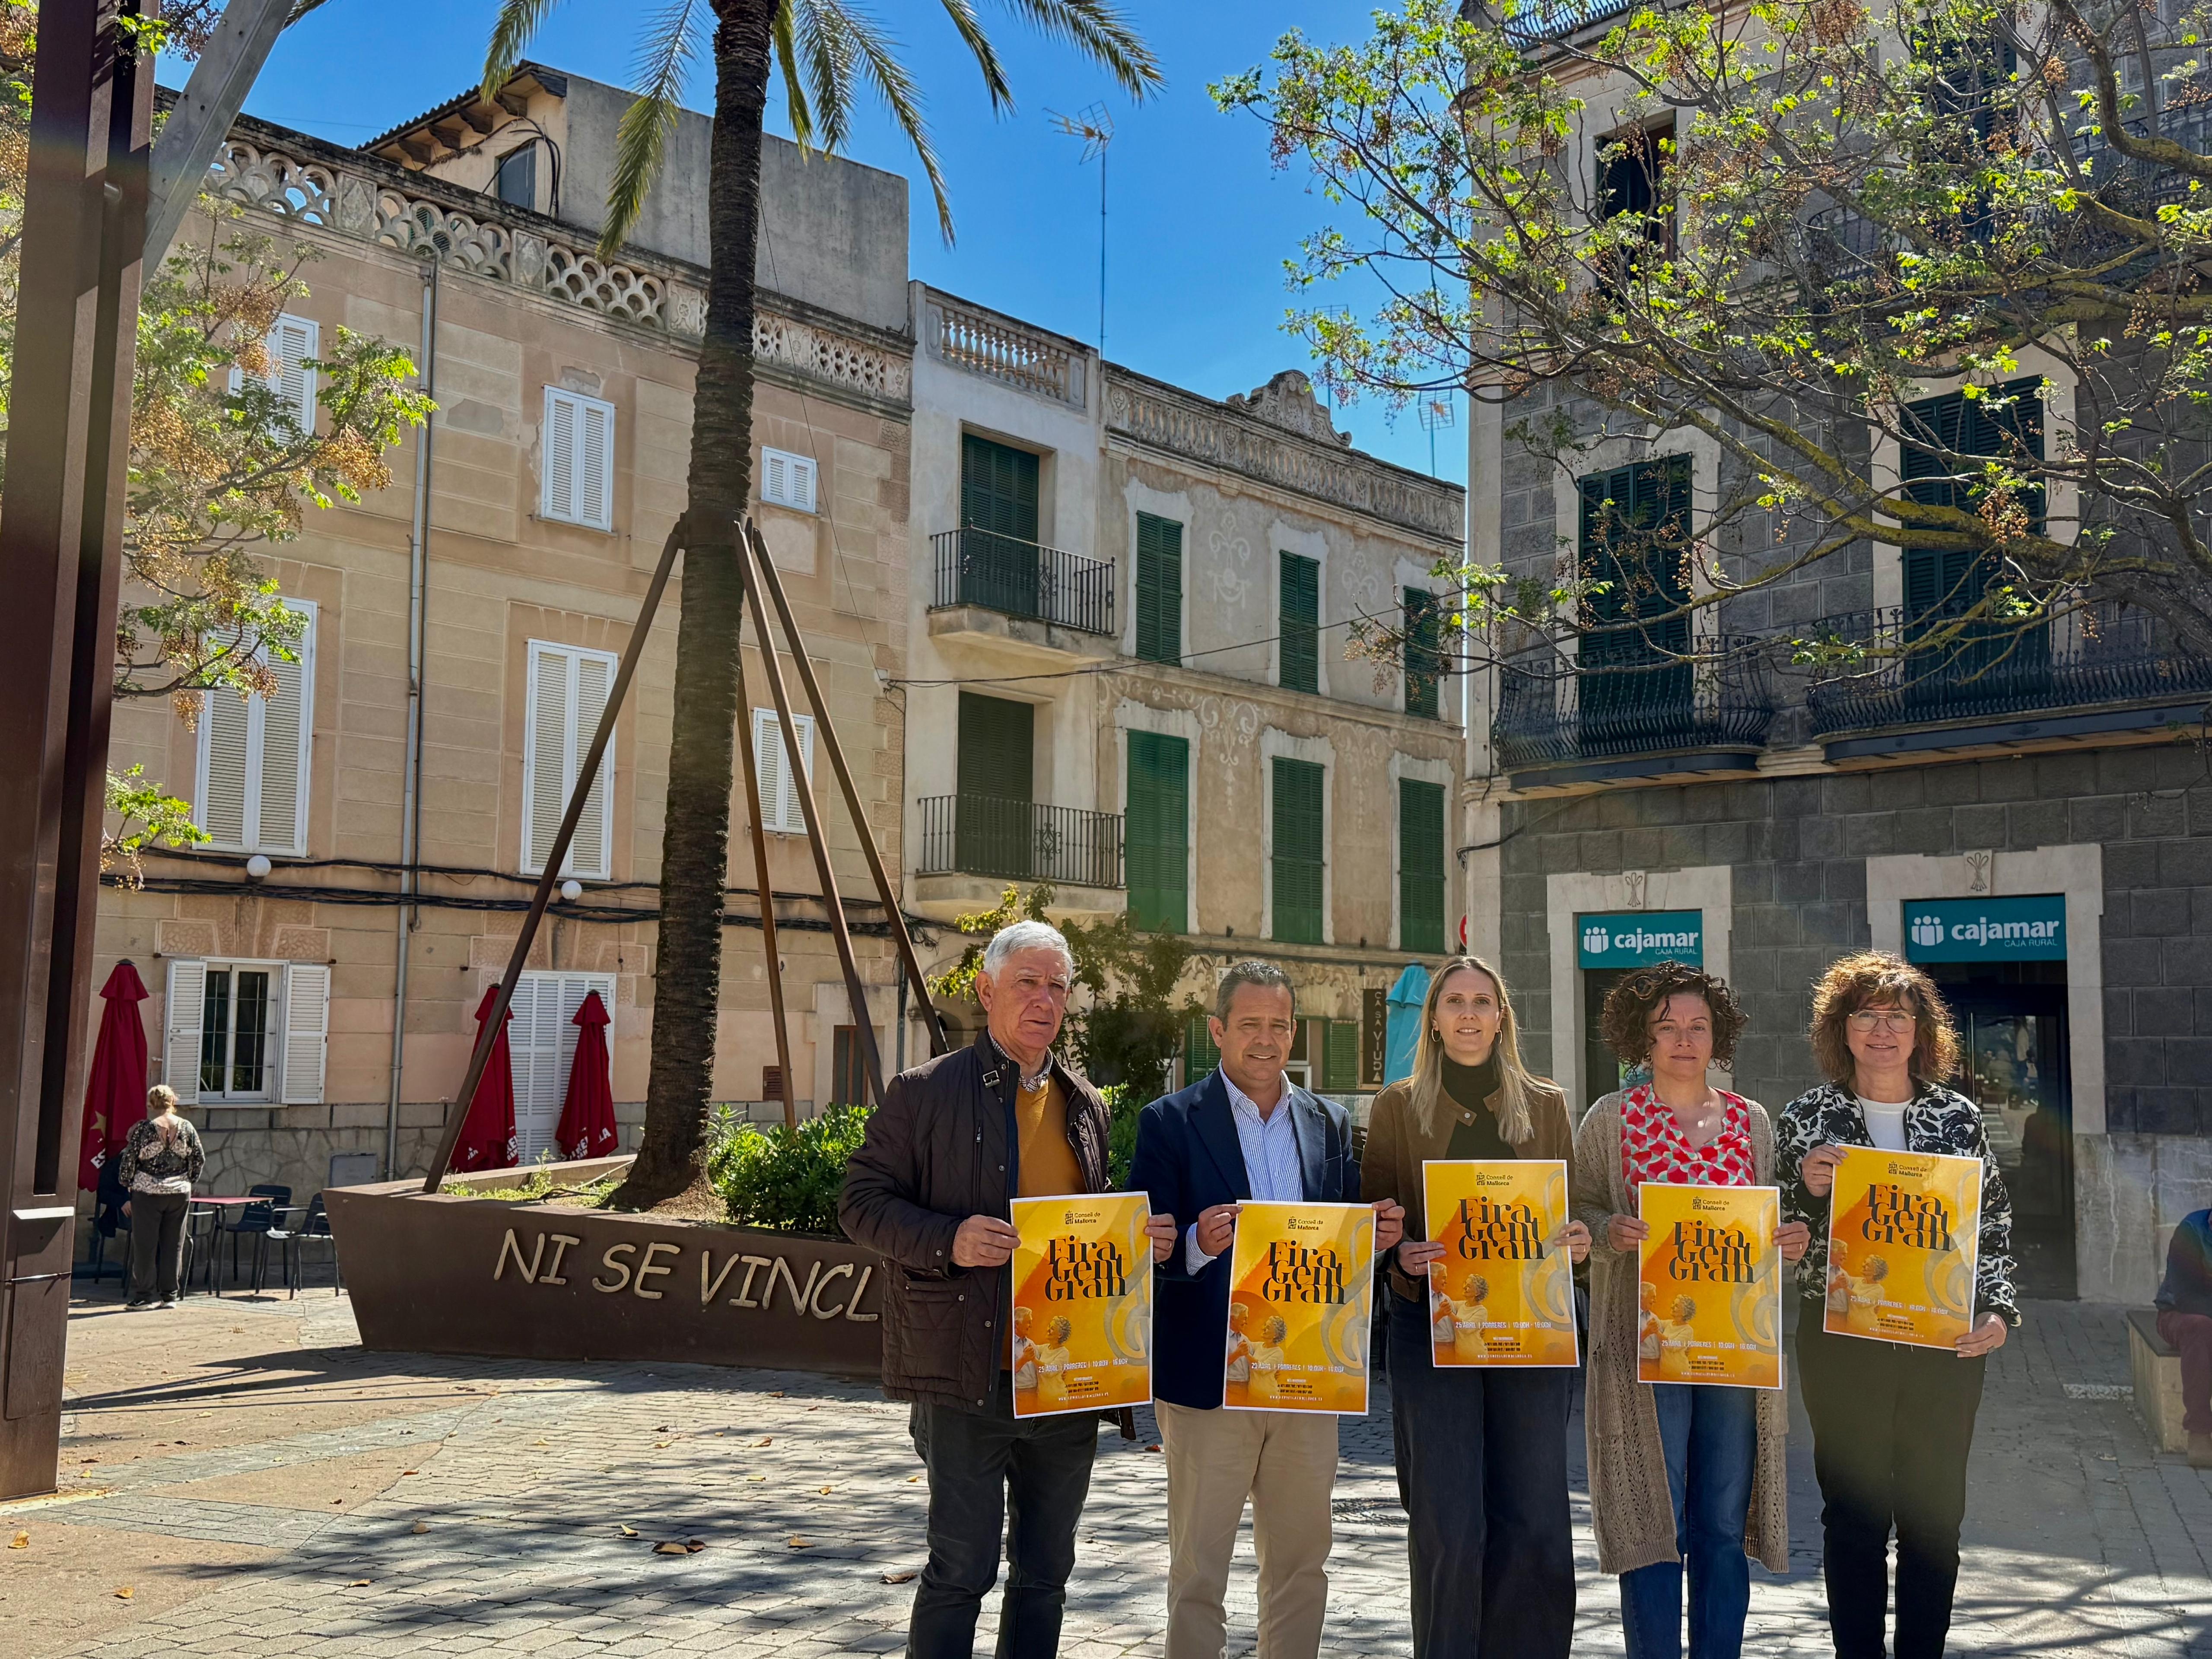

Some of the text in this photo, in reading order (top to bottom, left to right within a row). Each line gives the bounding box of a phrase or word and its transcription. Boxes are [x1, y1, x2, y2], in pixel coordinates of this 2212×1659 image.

[1614, 928, 1699, 954] cajamar
[1951, 916, 2059, 947] cajamar
[1459, 1196, 1532, 1224] Fira
[1867, 1183, 1943, 1216] Fira
[1465, 1216, 1543, 1242] Gent
[1871, 1202, 1952, 1235] Gent
[1459, 1234, 1546, 1260] Gran
[1673, 1220, 1745, 1248] Fira
[1862, 1217, 1951, 1252] Gran
[1048, 1235, 1116, 1265] Fira
[1268, 1240, 1337, 1268] Fira
[1678, 1239, 1754, 1266] Gent
[493, 1228, 879, 1322] NI SE VINCL
[1052, 1254, 1126, 1283] Gent
[1271, 1259, 1347, 1287] Gent
[1669, 1256, 1755, 1284] Gran
[1045, 1276, 1127, 1301] Gran
[1262, 1277, 1346, 1305] Gran
